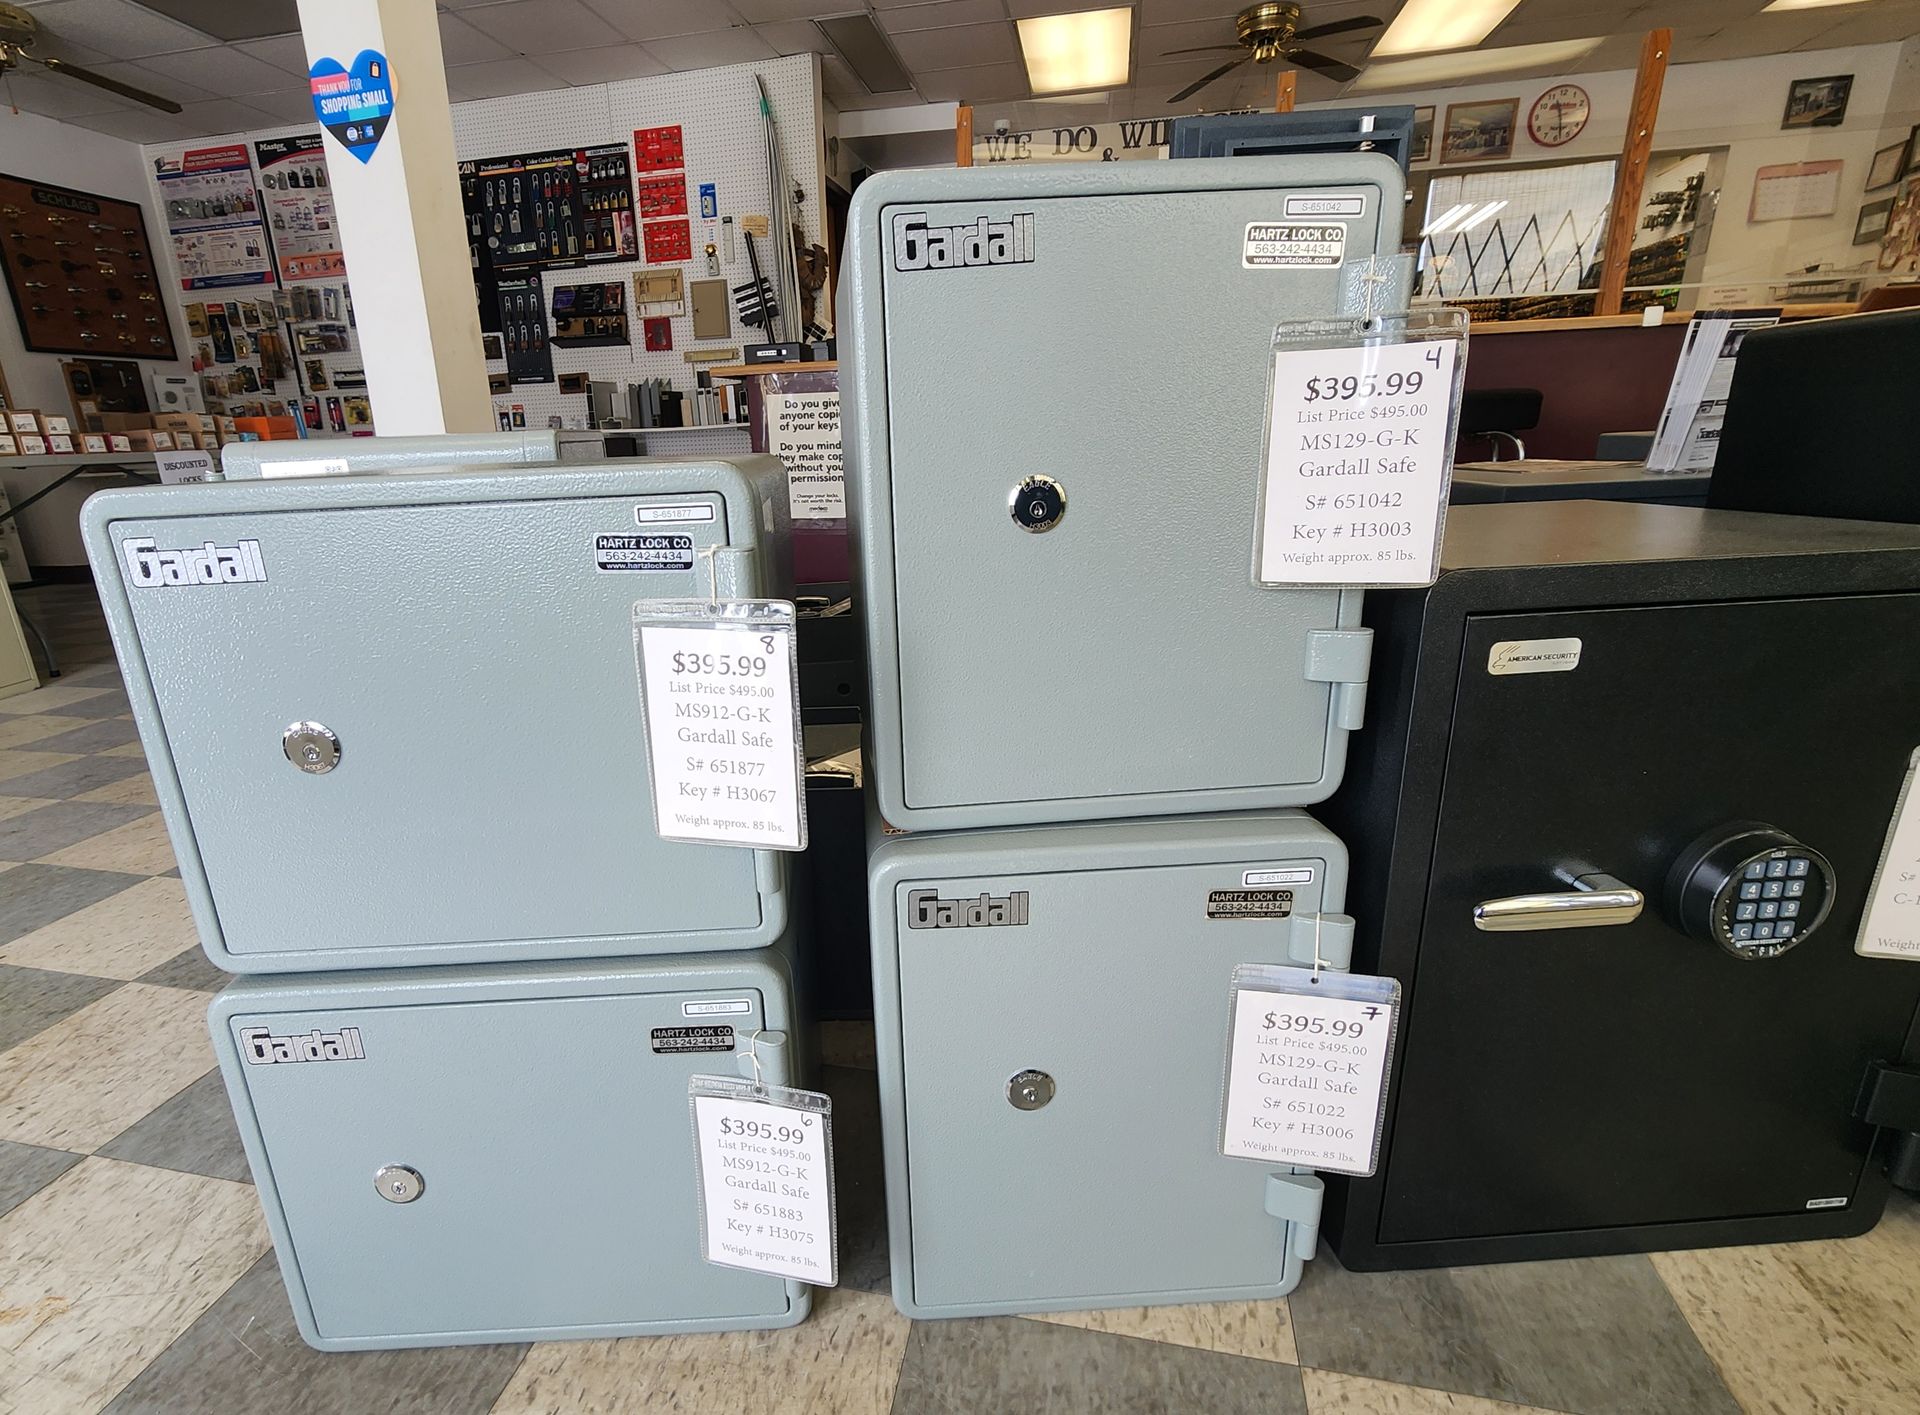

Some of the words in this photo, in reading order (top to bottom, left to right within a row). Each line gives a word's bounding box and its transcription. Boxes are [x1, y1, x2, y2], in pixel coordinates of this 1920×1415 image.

[318, 82, 339, 96] THANK
[339, 80, 350, 93] YOU
[350, 78, 362, 91] FOR
[321, 94, 361, 114] SHOPPING
[362, 89, 388, 107] SMALL
[985, 133, 1032, 163] WE
[1052, 126, 1097, 155] DO
[38, 192, 94, 211] SCHLAGE
[1302, 203, 1341, 211] S-651042
[892, 212, 1035, 272] Gardall
[1250, 228, 1289, 240] HARTZ
[1292, 229, 1322, 240] LOCK
[1325, 229, 1344, 240] CO.
[1254, 244, 1332, 254] 563-242-4434
[1254, 256, 1332, 264] www.hartzlock.com
[1425, 346, 1442, 370] 4
[1304, 371, 1423, 403] $395.99
[785, 400, 798, 408] Do
[801, 401, 819, 410] you
[1297, 410, 1322, 423] List
[1328, 408, 1365, 422] Price
[1370, 404, 1428, 419] $495.00
[780, 413, 815, 421] anyone
[780, 422, 790, 431] of
[793, 424, 815, 432] your
[818, 421, 839, 432] keys
[780, 443, 793, 451] Do
[796, 444, 813, 452] you
[817, 441, 841, 450] mind
[1300, 428, 1420, 451] MS129-G-K
[164, 460, 208, 471] DISCOUNTED
[799, 452, 824, 461] make
[1299, 458, 1369, 478] Gardall
[1377, 455, 1417, 474] Safe
[786, 463, 823, 472] without
[791, 474, 844, 484] permission
[1305, 495, 1327, 510] S#
[1334, 492, 1403, 509] 651042
[653, 509, 692, 518] S-651877
[1292, 524, 1327, 543] Key
[1333, 526, 1343, 537] #
[1350, 522, 1412, 537] H3003
[599, 538, 637, 548] HARTZ
[640, 538, 670, 548] LOCK
[674, 538, 692, 548] CO.
[122, 537, 268, 588] Gardall
[605, 551, 683, 561] 563-242-4434
[1282, 551, 1324, 565] Weight
[1328, 553, 1373, 565] approx.
[1377, 551, 1391, 561] 85
[1395, 549, 1416, 561] lbs.
[760, 635, 775, 655] 8
[671, 651, 766, 678] $395.99
[1507, 654, 1542, 662] AMERICAN
[1543, 652, 1578, 660] SECURITY
[669, 681, 691, 693] List
[695, 682, 725, 695] Price
[729, 683, 774, 698] $495.00
[675, 703, 772, 723] MS912-G-K
[677, 727, 736, 745] Gardall
[742, 731, 774, 748] Safe
[686, 757, 704, 772] S#
[710, 759, 765, 777] 651877
[679, 782, 708, 800] Key
[713, 786, 720, 796] #
[727, 786, 777, 803] H3067
[675, 813, 710, 828] Weight
[713, 817, 750, 830] approx.
[753, 821, 764, 830] 85
[768, 820, 785, 833] lbs.
[1755, 865, 1760, 873] 1
[1776, 863, 1783, 872] 2
[1797, 862, 1804, 871] 3
[1211, 893, 1245, 901] HARTZ
[1277, 892, 1293, 900] CO.
[1749, 885, 1756, 893] 4
[1771, 884, 1778, 892] 5
[1793, 883, 1799, 891] 6
[908, 889, 1029, 929] Gardall
[1215, 903, 1283, 911] 563-242-4434
[1746, 906, 1752, 914] 7
[1788, 903, 1795, 911] 9
[1740, 928, 1748, 936] C
[654, 1029, 686, 1038] HARTZ
[689, 1028, 715, 1036] LOCK
[718, 1027, 734, 1035] CO.
[1262, 1011, 1364, 1039] $395.99
[240, 1026, 365, 1065] Gardall
[660, 1038, 726, 1046] 563-242-4434
[1256, 1035, 1278, 1046] List
[1283, 1037, 1314, 1049] Price
[1319, 1041, 1368, 1056] $495.00
[1259, 1052, 1361, 1076] MS129-G-K
[1257, 1072, 1318, 1090] Gardall
[1324, 1080, 1358, 1095] Safe
[1263, 1097, 1281, 1109] S#
[1287, 1100, 1345, 1118] 651022
[720, 1116, 804, 1144] $395.99
[800, 1113, 812, 1127] 6
[1252, 1116, 1281, 1134] Key
[1286, 1121, 1295, 1130] #
[1301, 1123, 1354, 1140] H3006
[718, 1139, 737, 1150] List
[741, 1142, 767, 1155] Price
[771, 1146, 811, 1162] $495.00
[1242, 1140, 1278, 1154] Weight
[1281, 1146, 1320, 1159] approx.
[1323, 1151, 1335, 1159] 85
[1338, 1152, 1355, 1163] lbs.
[723, 1156, 809, 1181] MS912-G-K
[725, 1175, 776, 1193] Gardall
[782, 1183, 810, 1200] Safe
[734, 1199, 749, 1211] S#
[754, 1204, 803, 1221] 651883
[727, 1218, 752, 1236] Key
[757, 1226, 764, 1234] #
[769, 1225, 814, 1244] H3075
[722, 1242, 752, 1256] Weight
[755, 1248, 788, 1263] approx.
[791, 1256, 801, 1265] 85
[804, 1258, 820, 1268] lbs.
